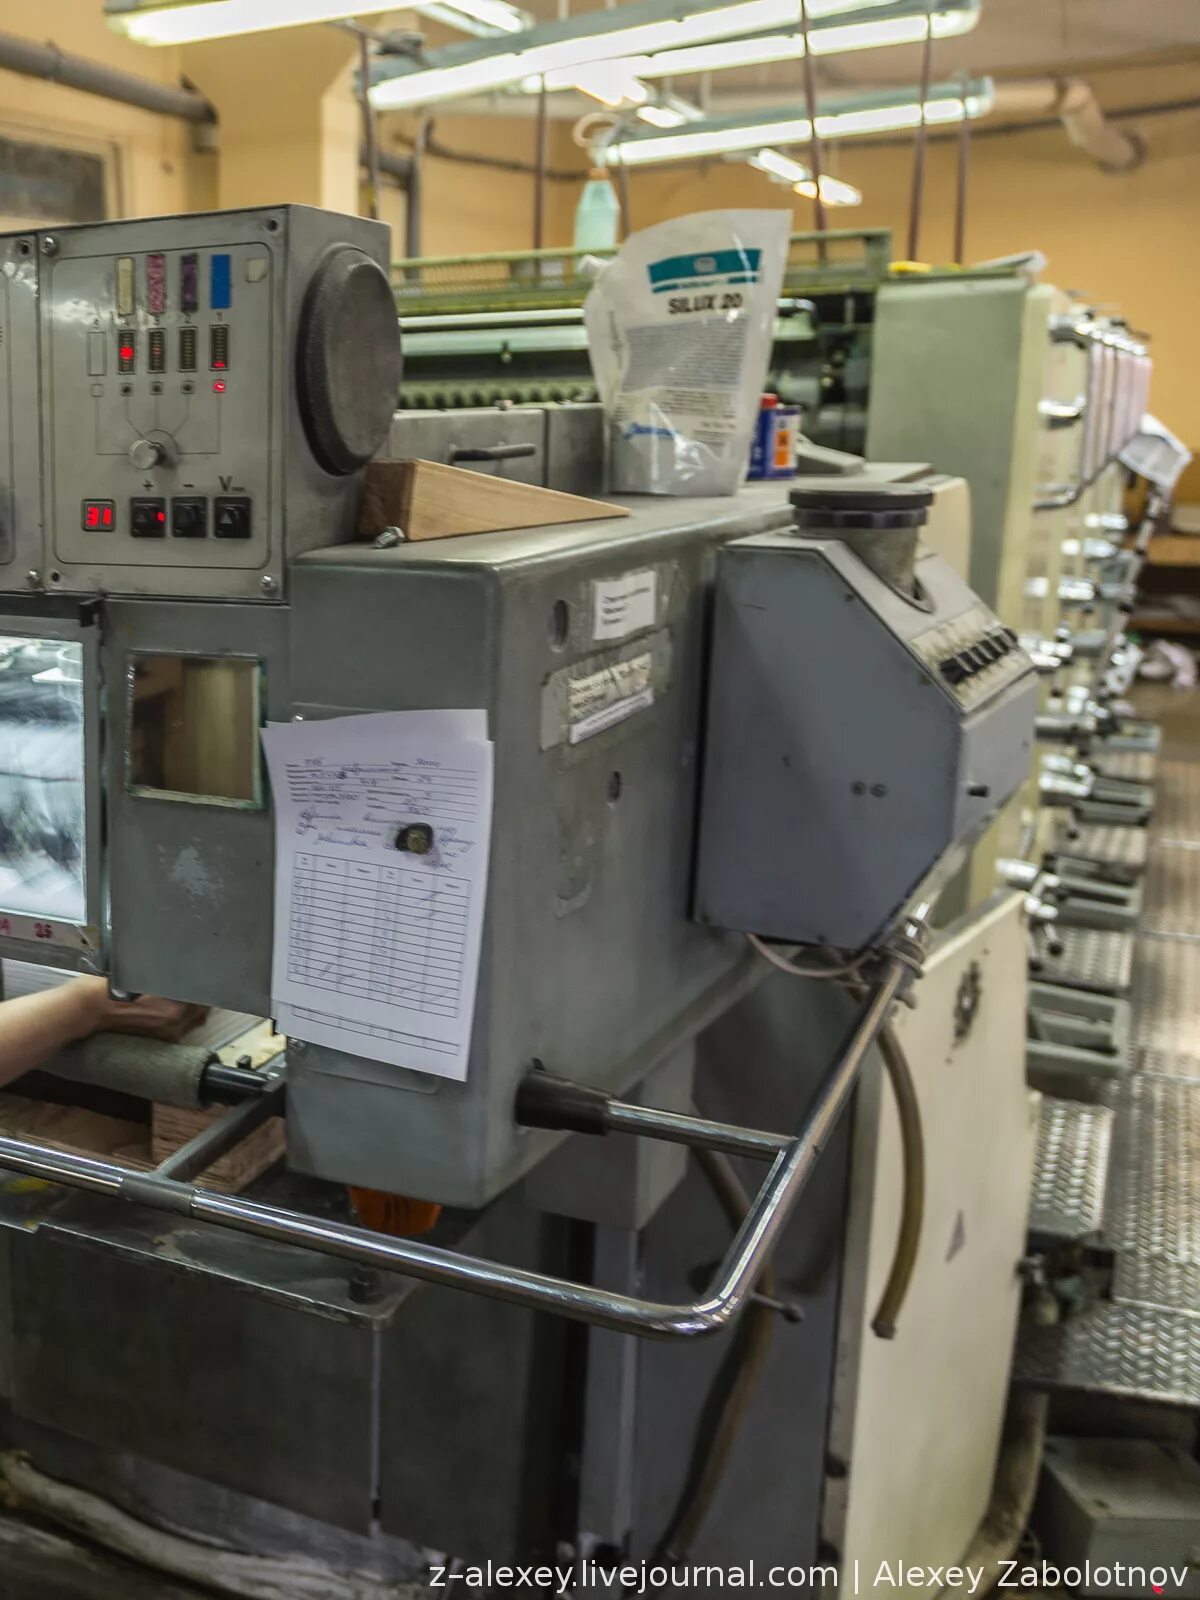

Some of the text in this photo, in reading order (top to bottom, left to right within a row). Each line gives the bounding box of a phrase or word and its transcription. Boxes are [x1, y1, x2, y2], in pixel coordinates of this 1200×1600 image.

[668, 292, 743, 314] SILUX 20
[85, 506, 112, 527] 31
[33, 922, 54, 939] 25
